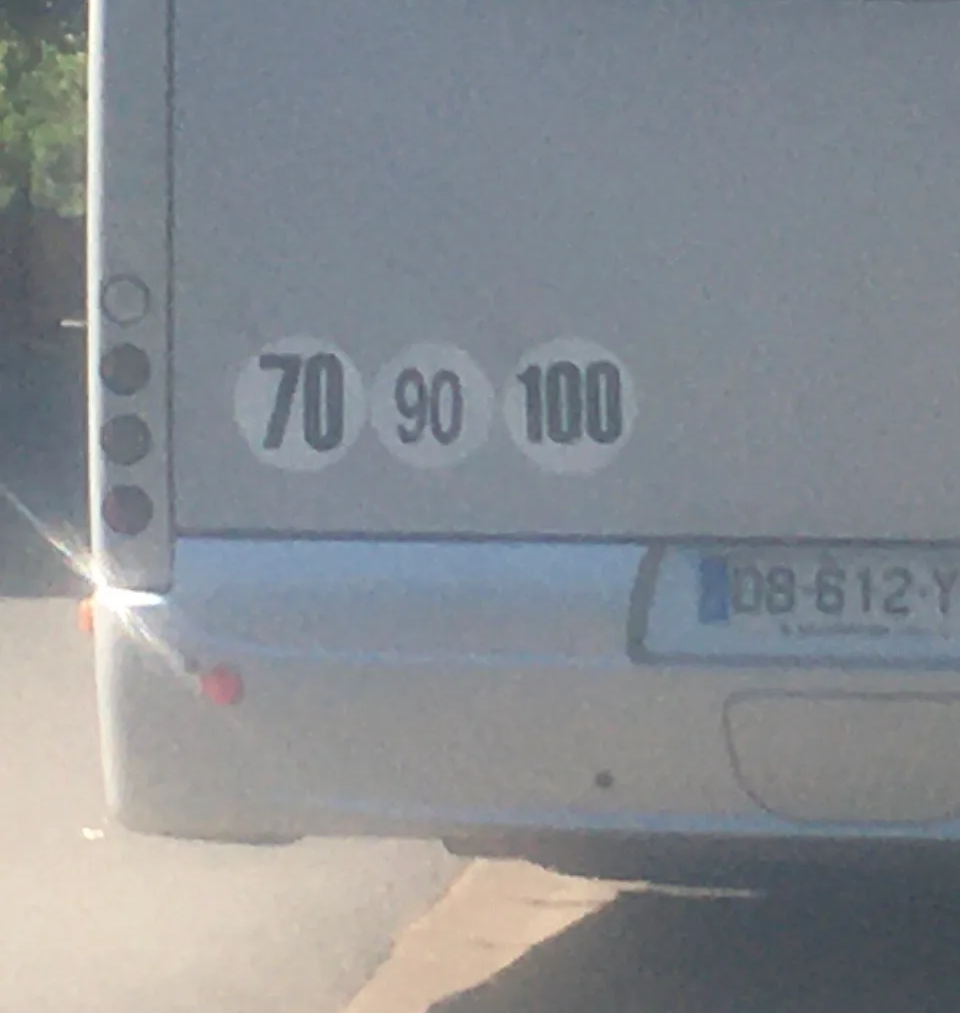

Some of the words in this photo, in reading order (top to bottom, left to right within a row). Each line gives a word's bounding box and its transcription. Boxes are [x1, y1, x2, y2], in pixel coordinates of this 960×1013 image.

[259, 352, 344, 452] 70
[394, 367, 464, 445] 90
[516, 359, 623, 445] 100
